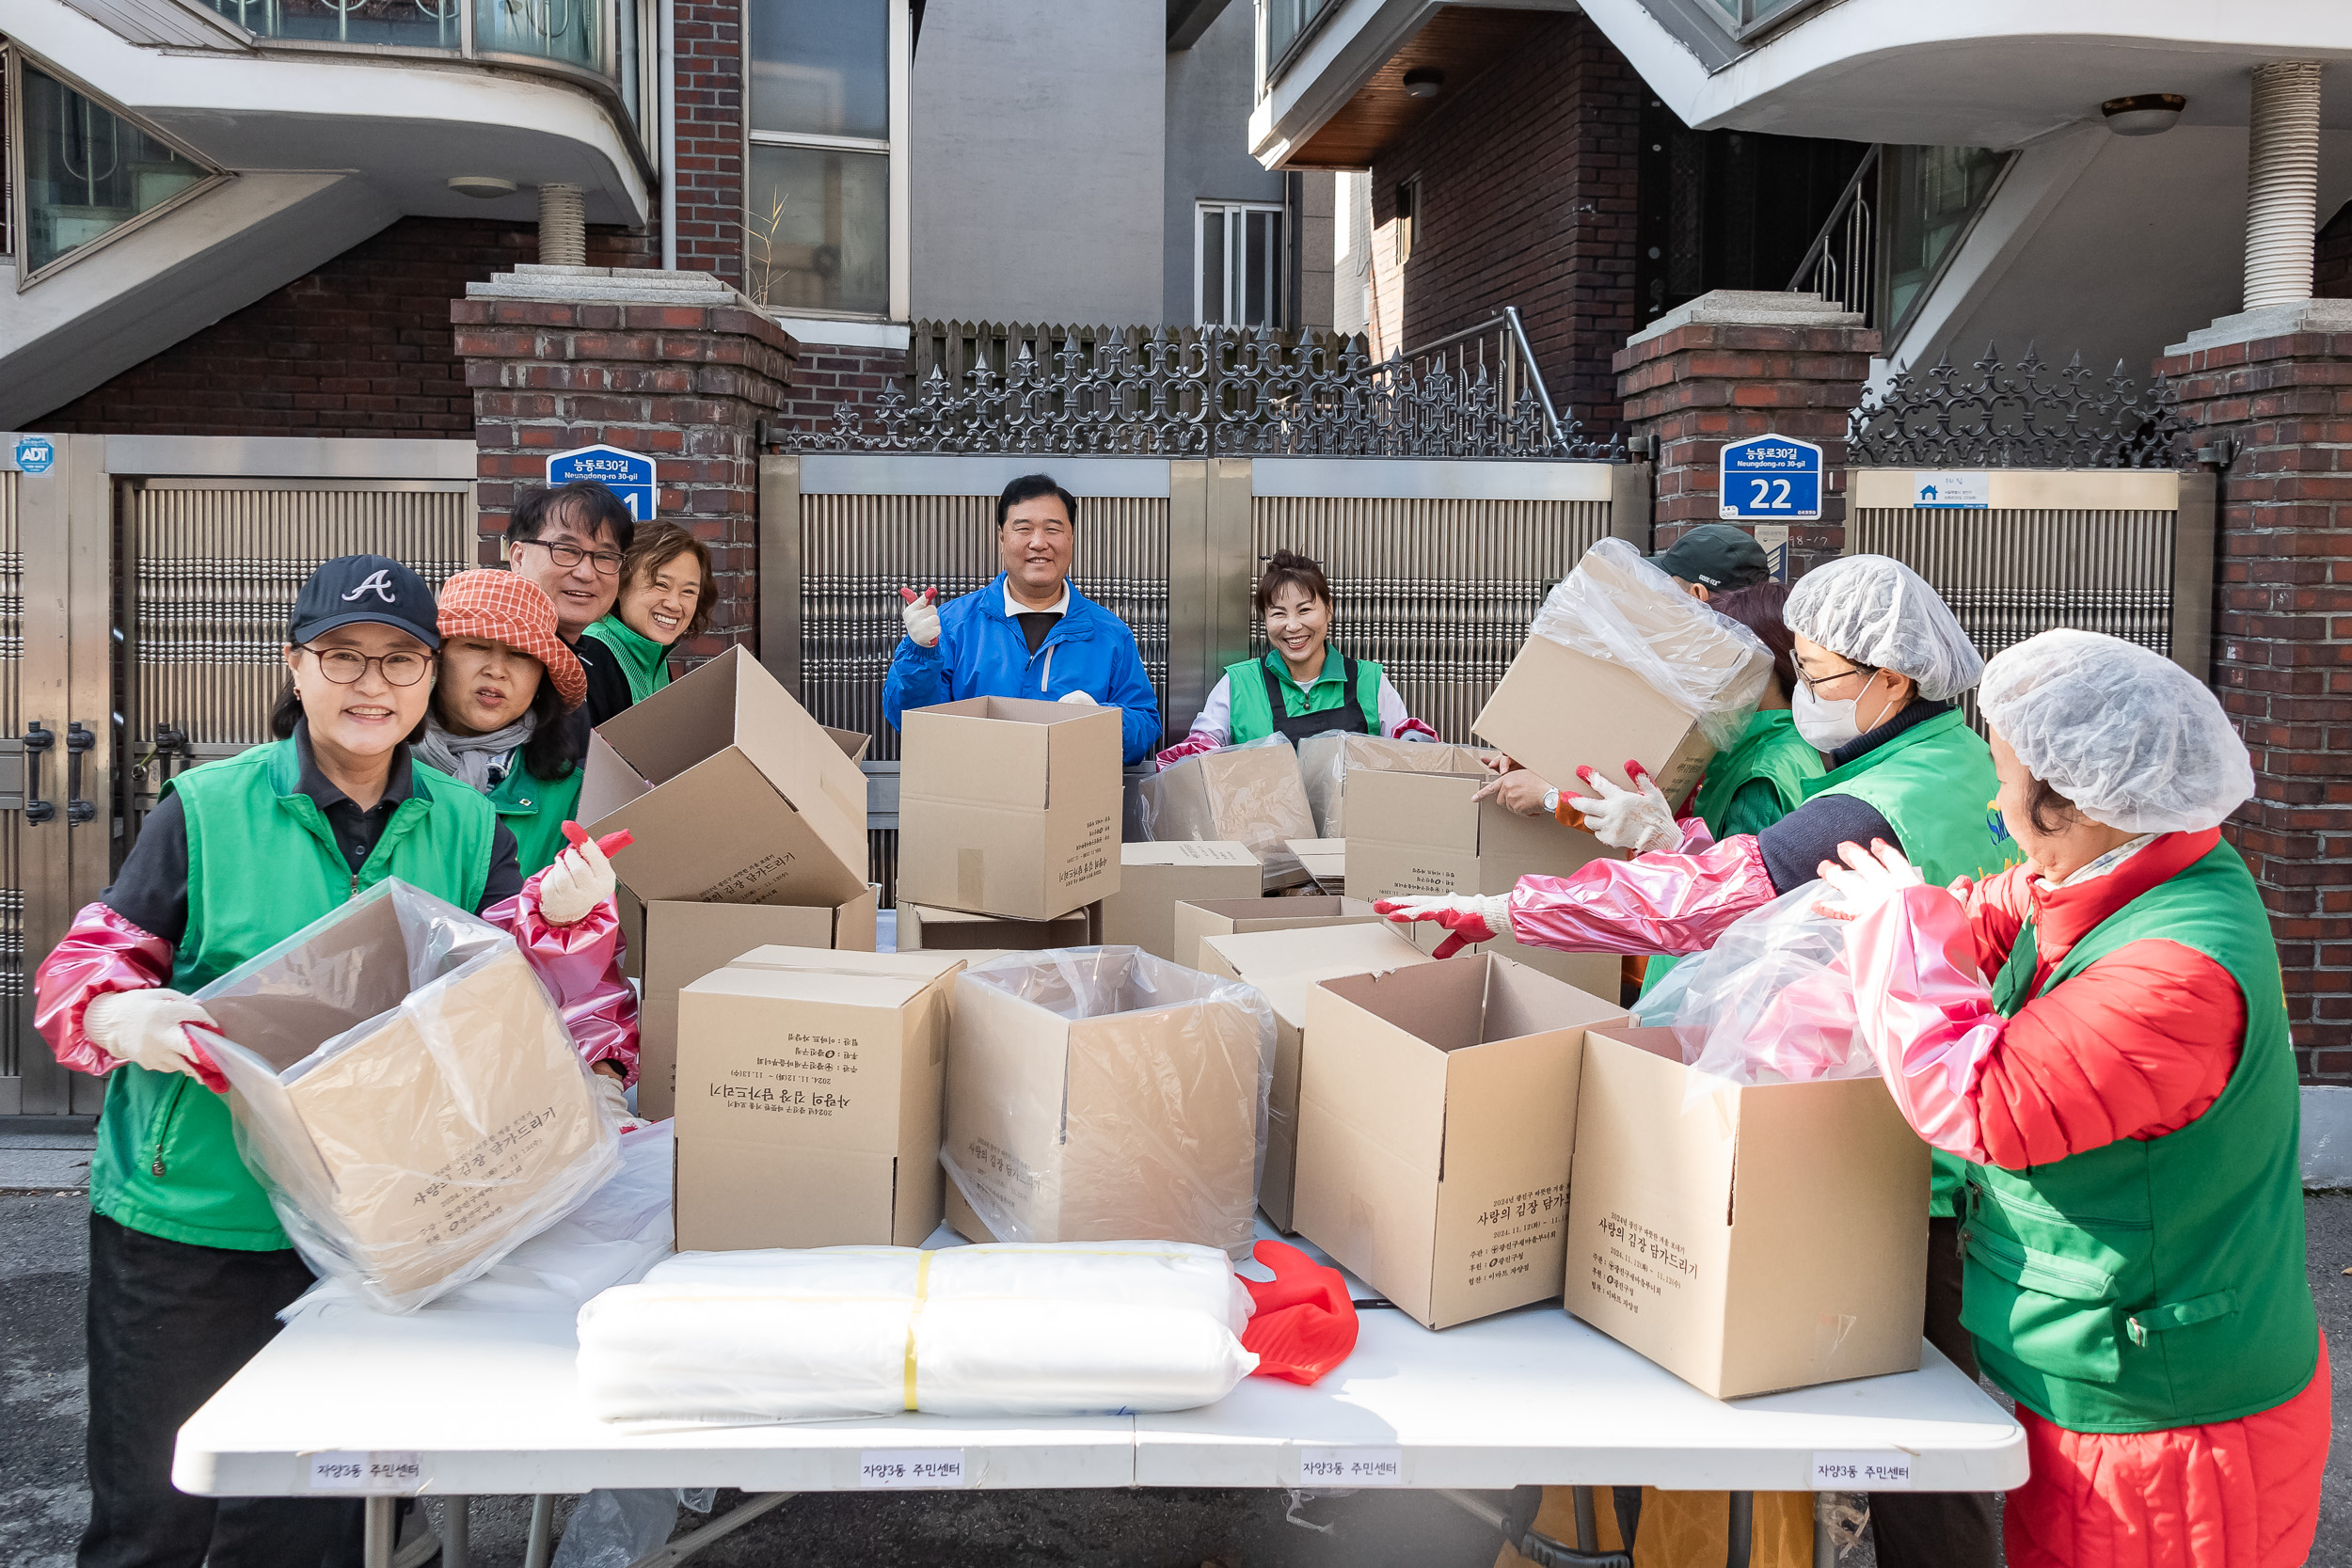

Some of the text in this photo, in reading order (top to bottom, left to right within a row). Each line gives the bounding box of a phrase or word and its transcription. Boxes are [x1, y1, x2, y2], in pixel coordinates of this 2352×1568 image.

[22, 448, 48, 461] ADT
[1746, 449, 1797, 460] 능동로30길
[574, 459, 628, 472] 능동로30길
[564, 472, 616, 481] Neungdong-ro
[1750, 479, 1791, 509] 22
[342, 569, 395, 603] A
[723, 880, 744, 895] 김장
[746, 852, 795, 882] 담가드리기
[787, 1034, 810, 1042] 자양점
[812, 1036, 834, 1044] 이마트
[795, 1048, 824, 1057] 광진구청
[843, 1051, 858, 1059] 후원
[756, 1057, 824, 1070] 광진구새마을부녀회
[843, 1065, 858, 1073] 주관
[775, 1073, 795, 1082] 12(화)
[709, 1083, 850, 1108] 사랑의 김장 담가드리기
[727, 1101, 747, 1109] 보내기
[764, 1103, 784, 1112] 따뜻한
[786, 1106, 805, 1115] 광진구
[808, 1107, 833, 1116] 2024년
[458, 1154, 486, 1177] 김장
[489, 1106, 557, 1157] 담가드리기
[968, 1142, 987, 1164] 사랑의
[1493, 1196, 1514, 1207] 2024년
[1516, 1192, 1533, 1201] 광진구
[1535, 1187, 1551, 1197] 따뜻한
[1477, 1207, 1511, 1227] 사랑의
[1516, 1200, 1538, 1217] 김장
[1524, 1221, 1540, 1230] 12(화)
[1611, 1212, 1685, 1255] 2024년 광진구 따뜻한 겨울 보내기
[1470, 1249, 1483, 1259] 주관
[1499, 1230, 1556, 1251] 광진구새마을부녀회
[1598, 1218, 1698, 1279] 사랑의 김장 담가드리기
[1470, 1261, 1482, 1272] 후원
[1498, 1252, 1524, 1265] 광진구청
[1634, 1259, 1648, 1272] 12(화)
[1469, 1276, 1482, 1286] 협찬
[1488, 1270, 1508, 1280] 이마트
[1510, 1263, 1530, 1275] 자양점
[1593, 1252, 1602, 1265] 주관
[1614, 1264, 1661, 1296] 광진구새마을부녀회
[1592, 1267, 1602, 1279] 후원
[1613, 1279, 1634, 1296] 광진구청
[1591, 1281, 1601, 1292] 협찬
[1606, 1291, 1621, 1304] 이마트
[1623, 1298, 1639, 1313] 자양점
[317, 1464, 419, 1478] 자양3동 주민센터
[863, 1463, 960, 1478] 자양3동 주민센터
[1303, 1462, 1396, 1475] 자양3동 주민센터
[1818, 1465, 1909, 1480] 자양3동 주민센터
